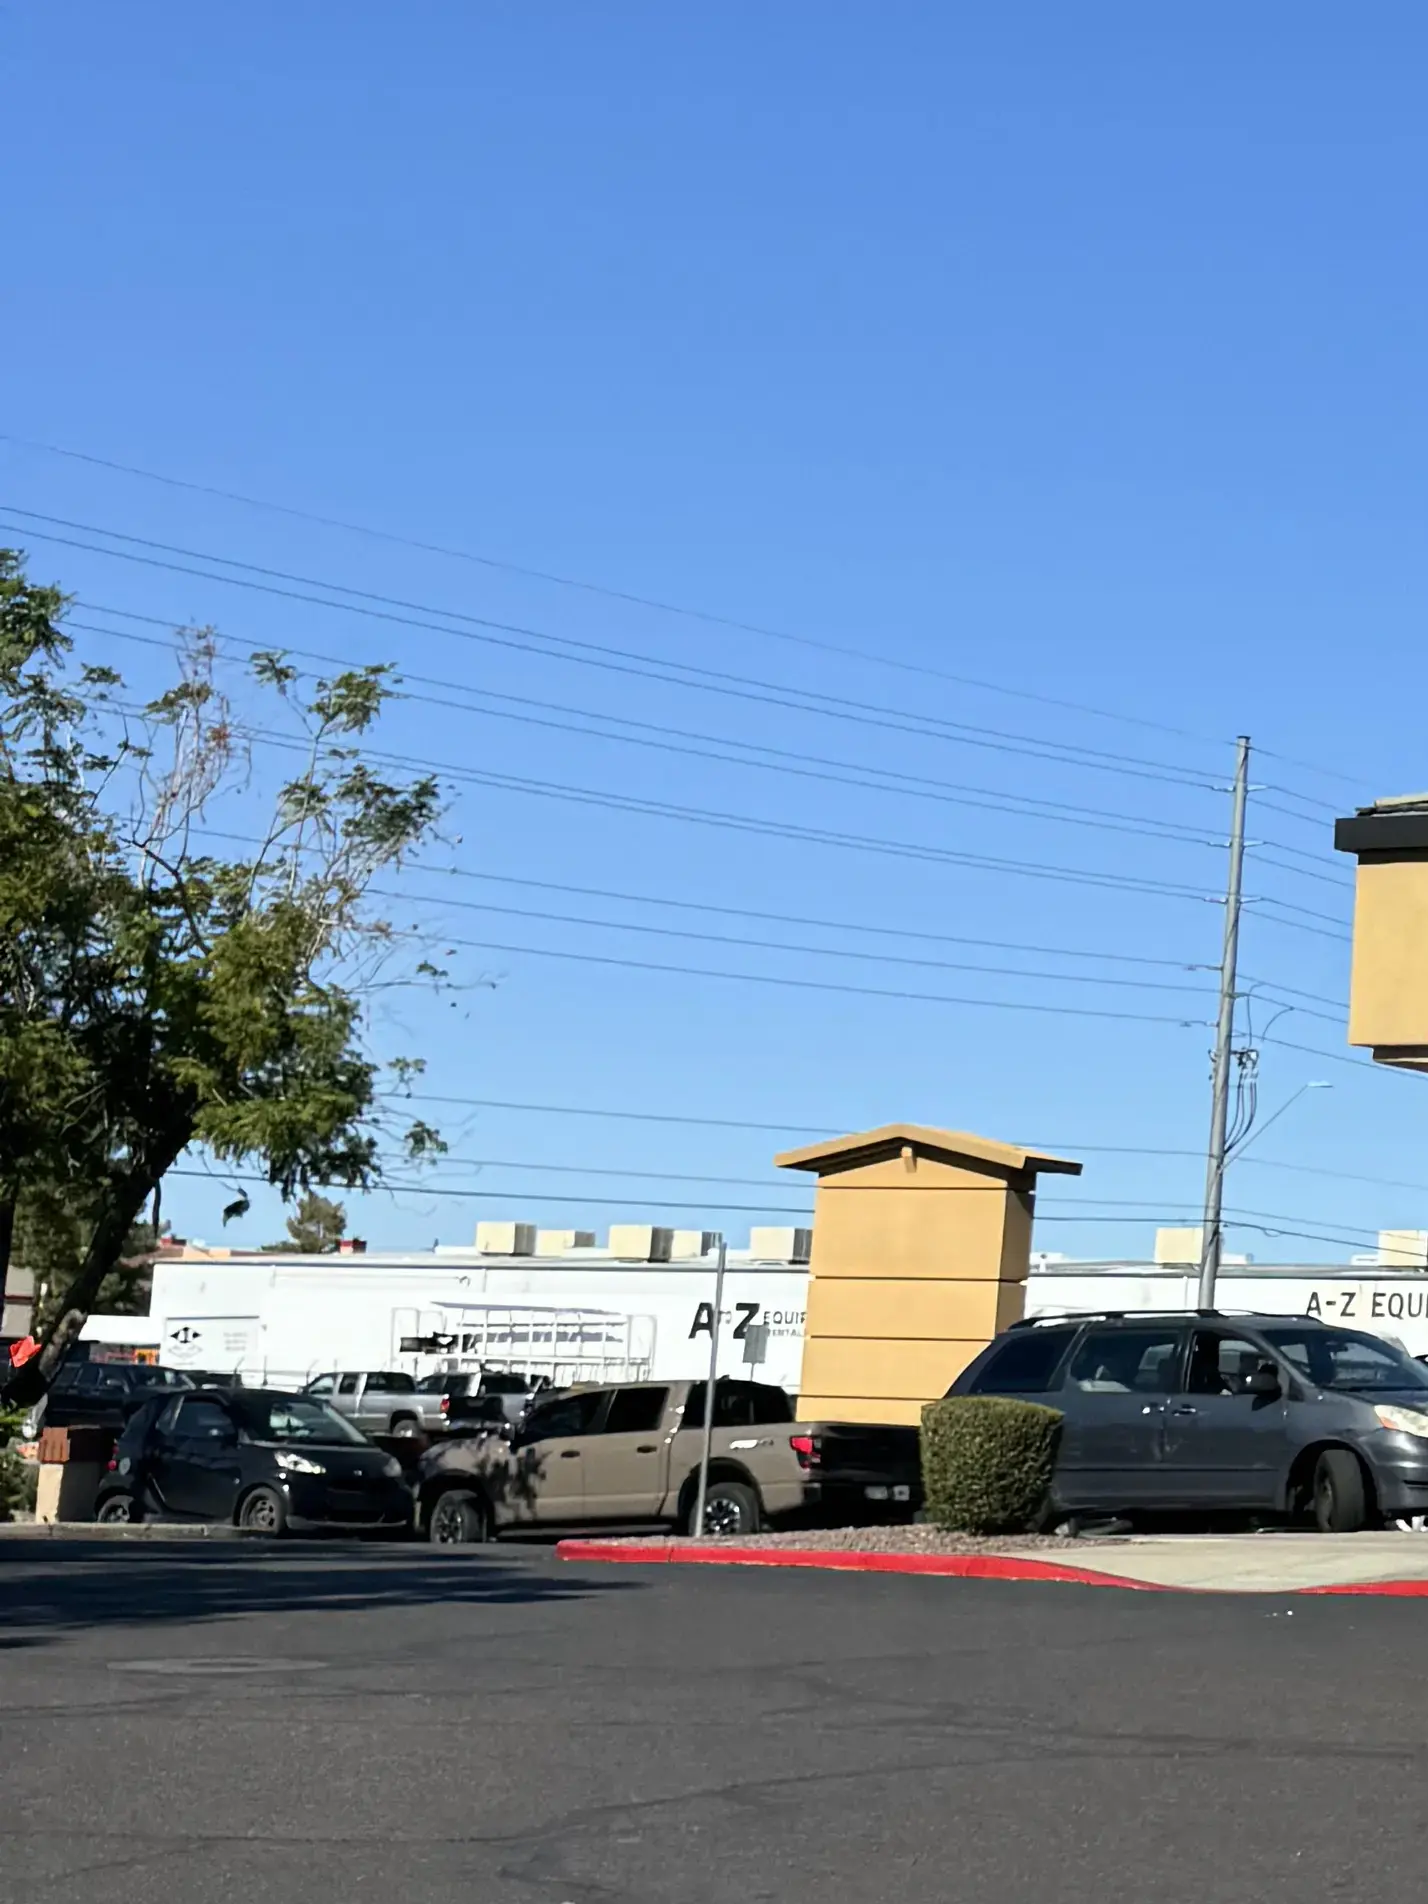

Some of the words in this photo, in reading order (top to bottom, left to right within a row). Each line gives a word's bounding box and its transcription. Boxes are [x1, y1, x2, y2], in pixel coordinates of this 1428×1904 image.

[1306, 1291, 1357, 1317] A-Z
[688, 1302, 714, 1339] A
[733, 1302, 760, 1339] Z
